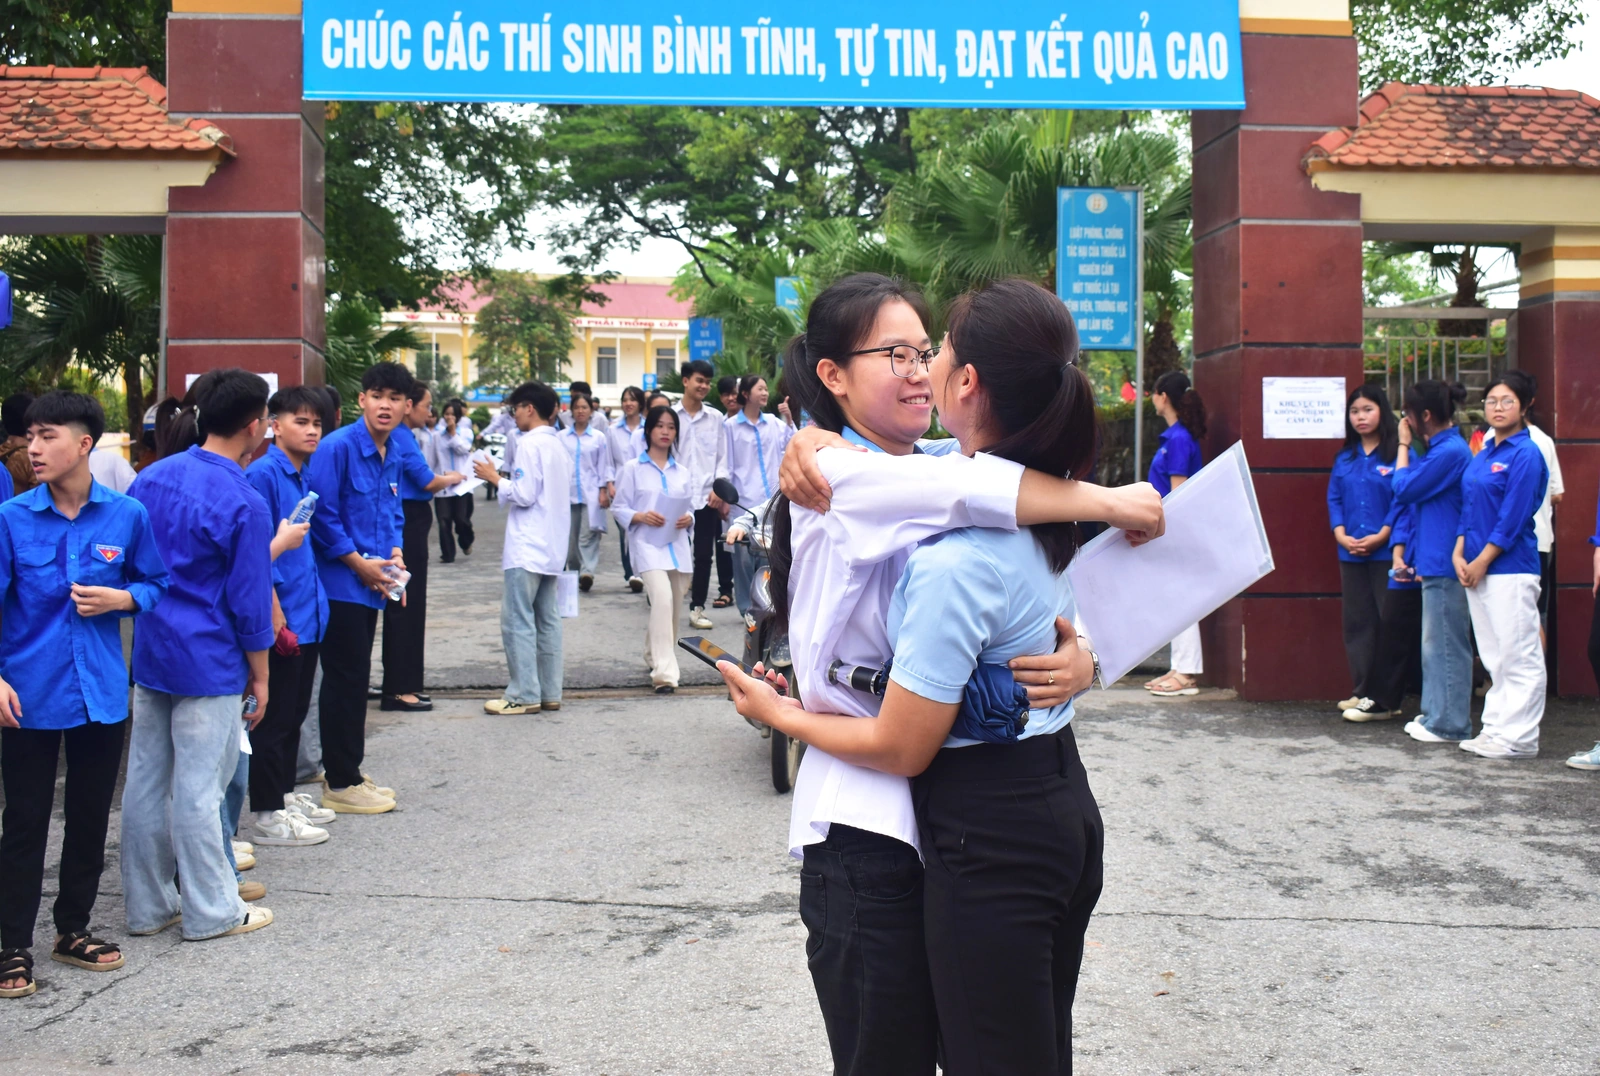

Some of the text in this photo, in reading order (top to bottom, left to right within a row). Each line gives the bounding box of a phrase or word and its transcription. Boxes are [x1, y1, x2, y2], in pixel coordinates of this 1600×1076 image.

[321, 9, 1229, 89] CHÚC CÁC THÍ SINH BÌNH TĨNH, TỰ TIN, ĐẠT KẾT QUẢ CAO
